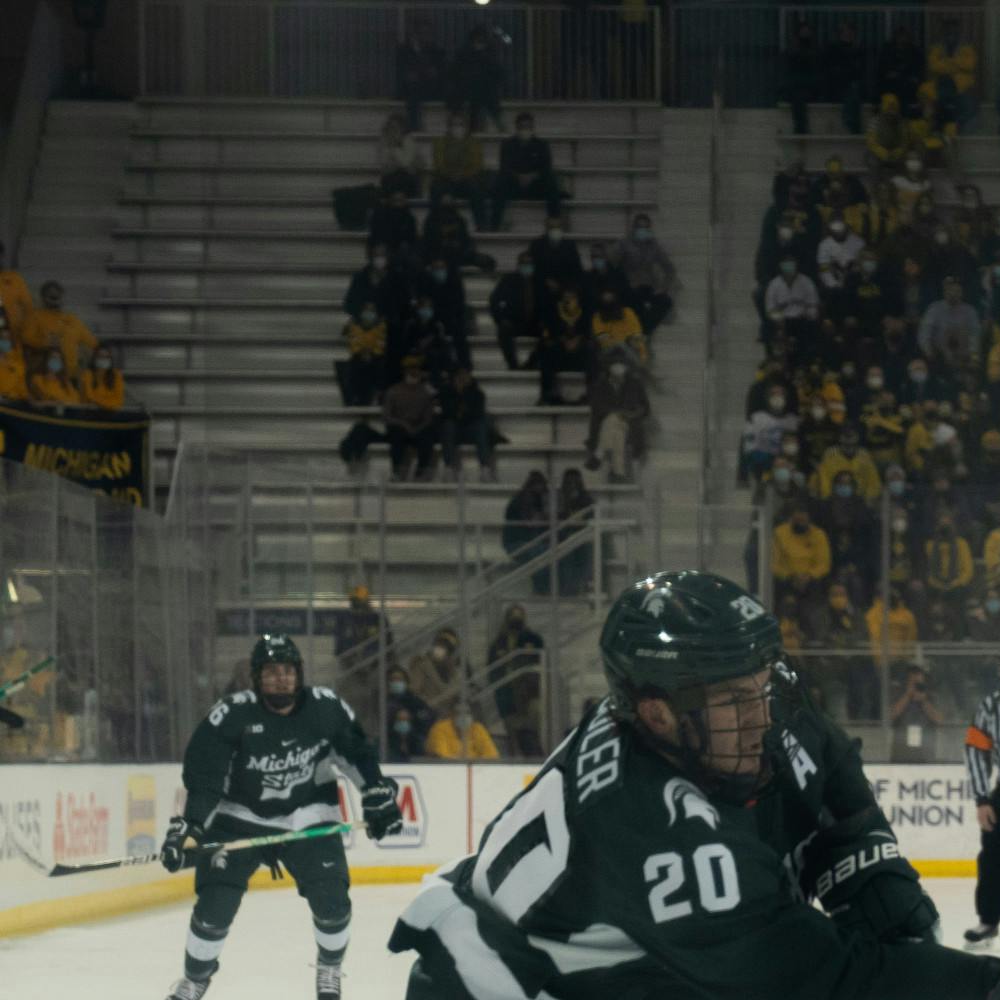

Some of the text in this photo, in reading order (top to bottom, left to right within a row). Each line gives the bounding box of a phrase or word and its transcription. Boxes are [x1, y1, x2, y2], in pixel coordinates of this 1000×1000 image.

[897, 778, 974, 801] MICHI
[642, 842, 742, 924] 20
[816, 841, 899, 899] BAUE
